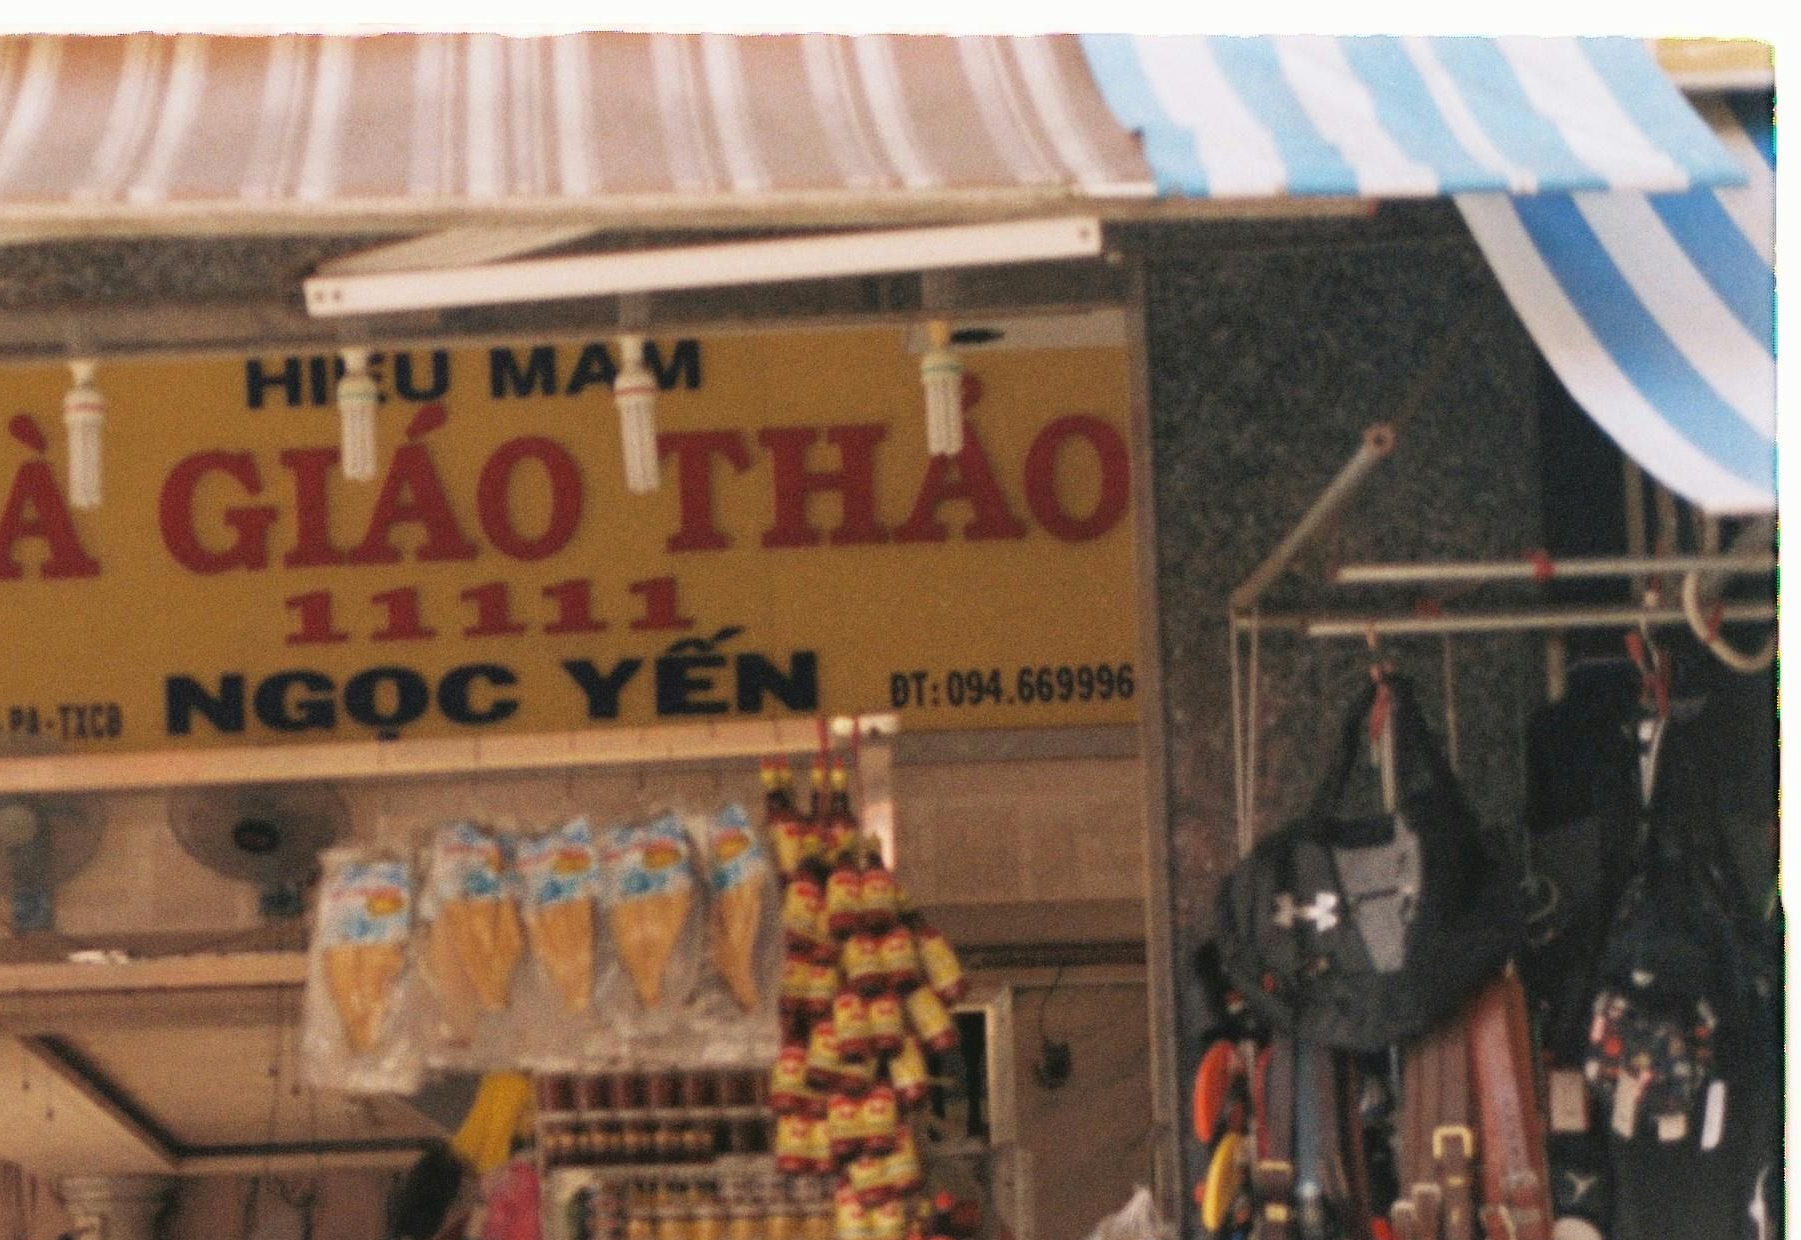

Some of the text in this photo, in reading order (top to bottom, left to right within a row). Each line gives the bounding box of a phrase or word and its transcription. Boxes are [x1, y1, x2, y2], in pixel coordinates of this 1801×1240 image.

[158, 401, 585, 577] GIÁO
[284, 576, 697, 647] 11111
[166, 625, 819, 741] NGỌC YẾN
